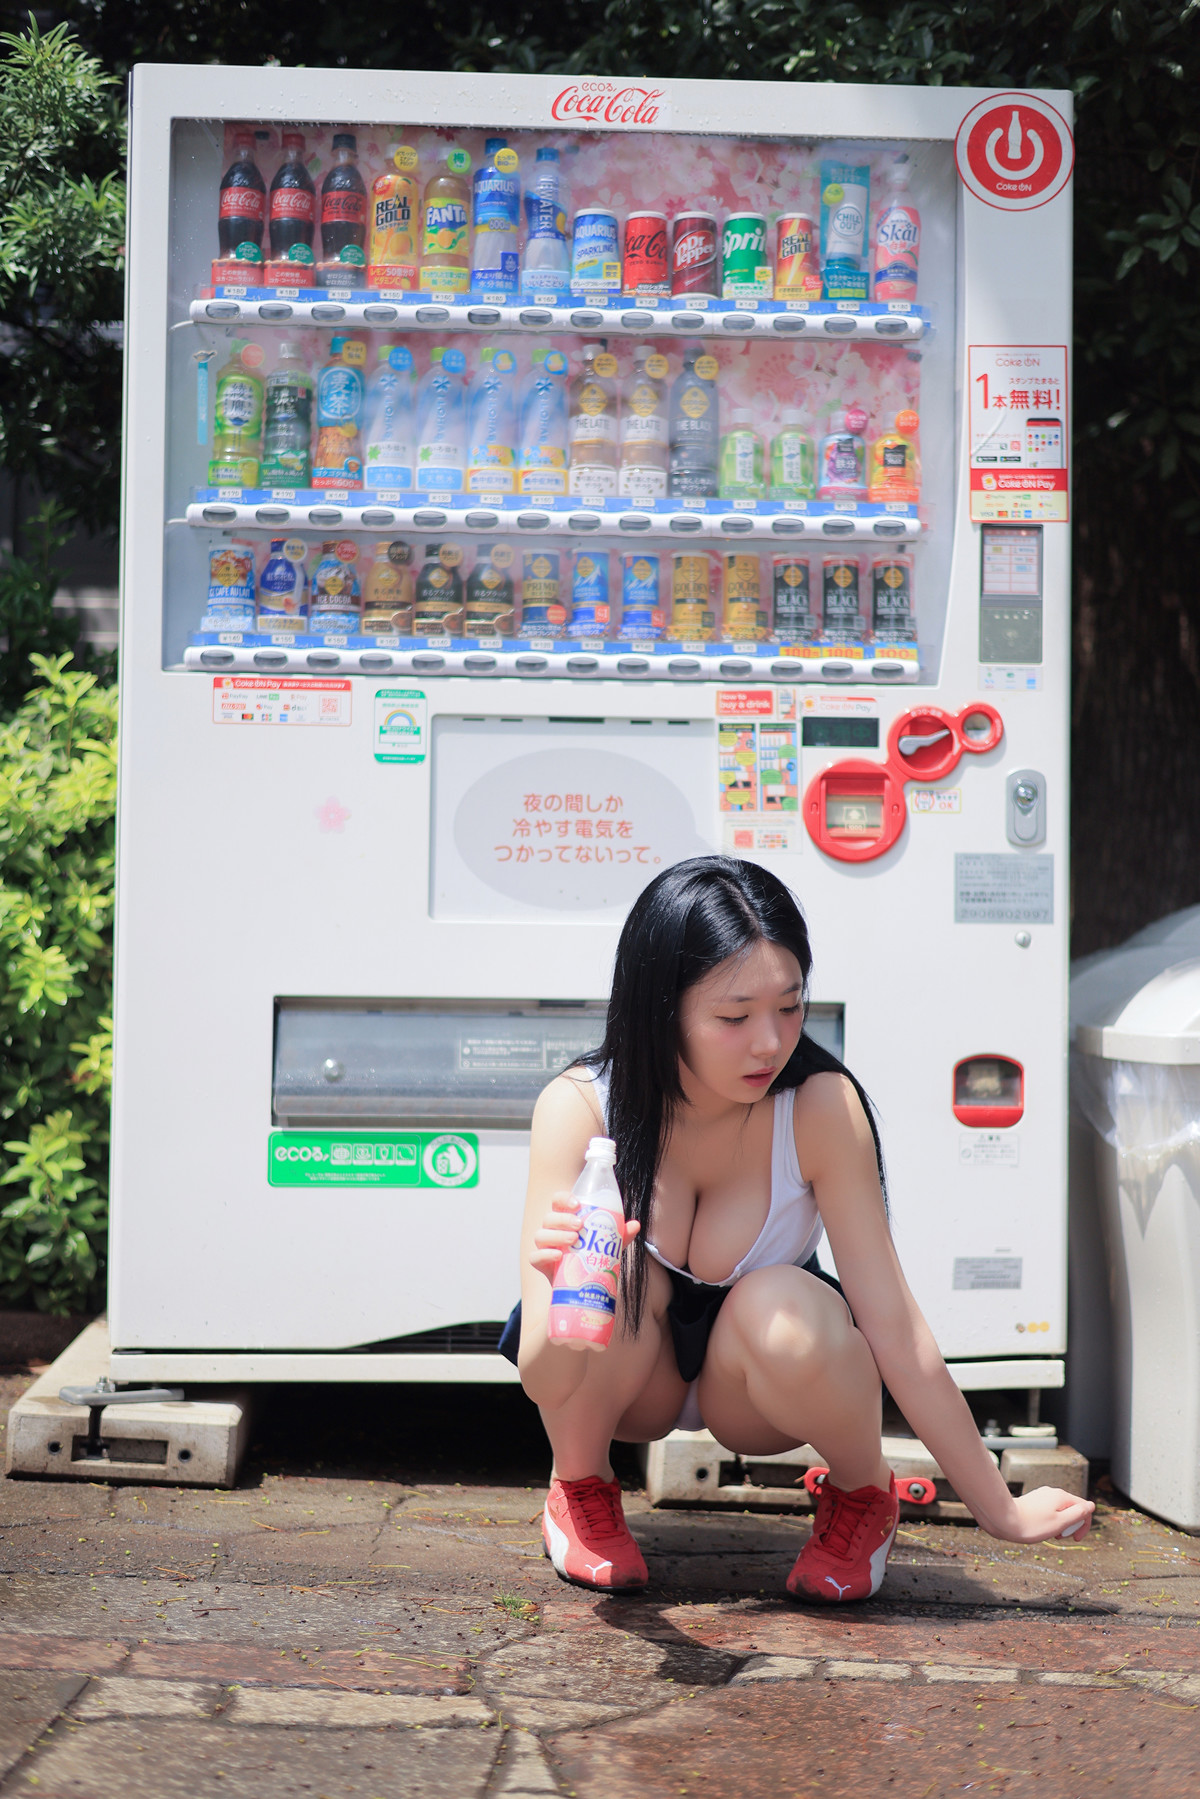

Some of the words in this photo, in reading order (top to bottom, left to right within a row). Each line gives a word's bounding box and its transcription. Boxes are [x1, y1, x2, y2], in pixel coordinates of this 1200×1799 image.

[551, 86, 666, 124] Coca-Cola
[475, 180, 514, 193] AQUARIUS
[996, 182, 1018, 191] Coke
[1018, 183, 1032, 192] ON
[222, 191, 260, 209] Coca-Cola
[272, 191, 311, 209] Coca-Cola
[376, 194, 410, 215] REAL
[376, 209, 411, 226] GOLD
[426, 205, 468, 225] FANTA
[837, 213, 861, 224] CHILL
[575, 225, 616, 239] AQUARIUS
[839, 222, 858, 231] OUT
[687, 235, 706, 248] Dr
[782, 231, 811, 248] REAL
[675, 244, 714, 267] Pepper
[782, 243, 811, 259] GOLD
[995, 358, 1022, 367] Coke
[1024, 357, 1040, 367] ON
[330, 373, 350, 414] 麦茶
[976, 373, 1061, 410] 1本無料!
[998, 480, 1021, 489] Coke
[1037, 480, 1056, 490] Pay
[235, 680, 254, 688] Coke
[254, 679, 266, 688] ON
[266, 680, 282, 689] Pay
[746, 700, 771, 709] drink
[856, 704, 873, 712] Pay
[523, 793, 624, 813] 夜の間しか
[512, 819, 634, 838] 冷やす電気を
[494, 845, 662, 864] つかってないって。
[586, 1252, 611, 1270] 白桃
